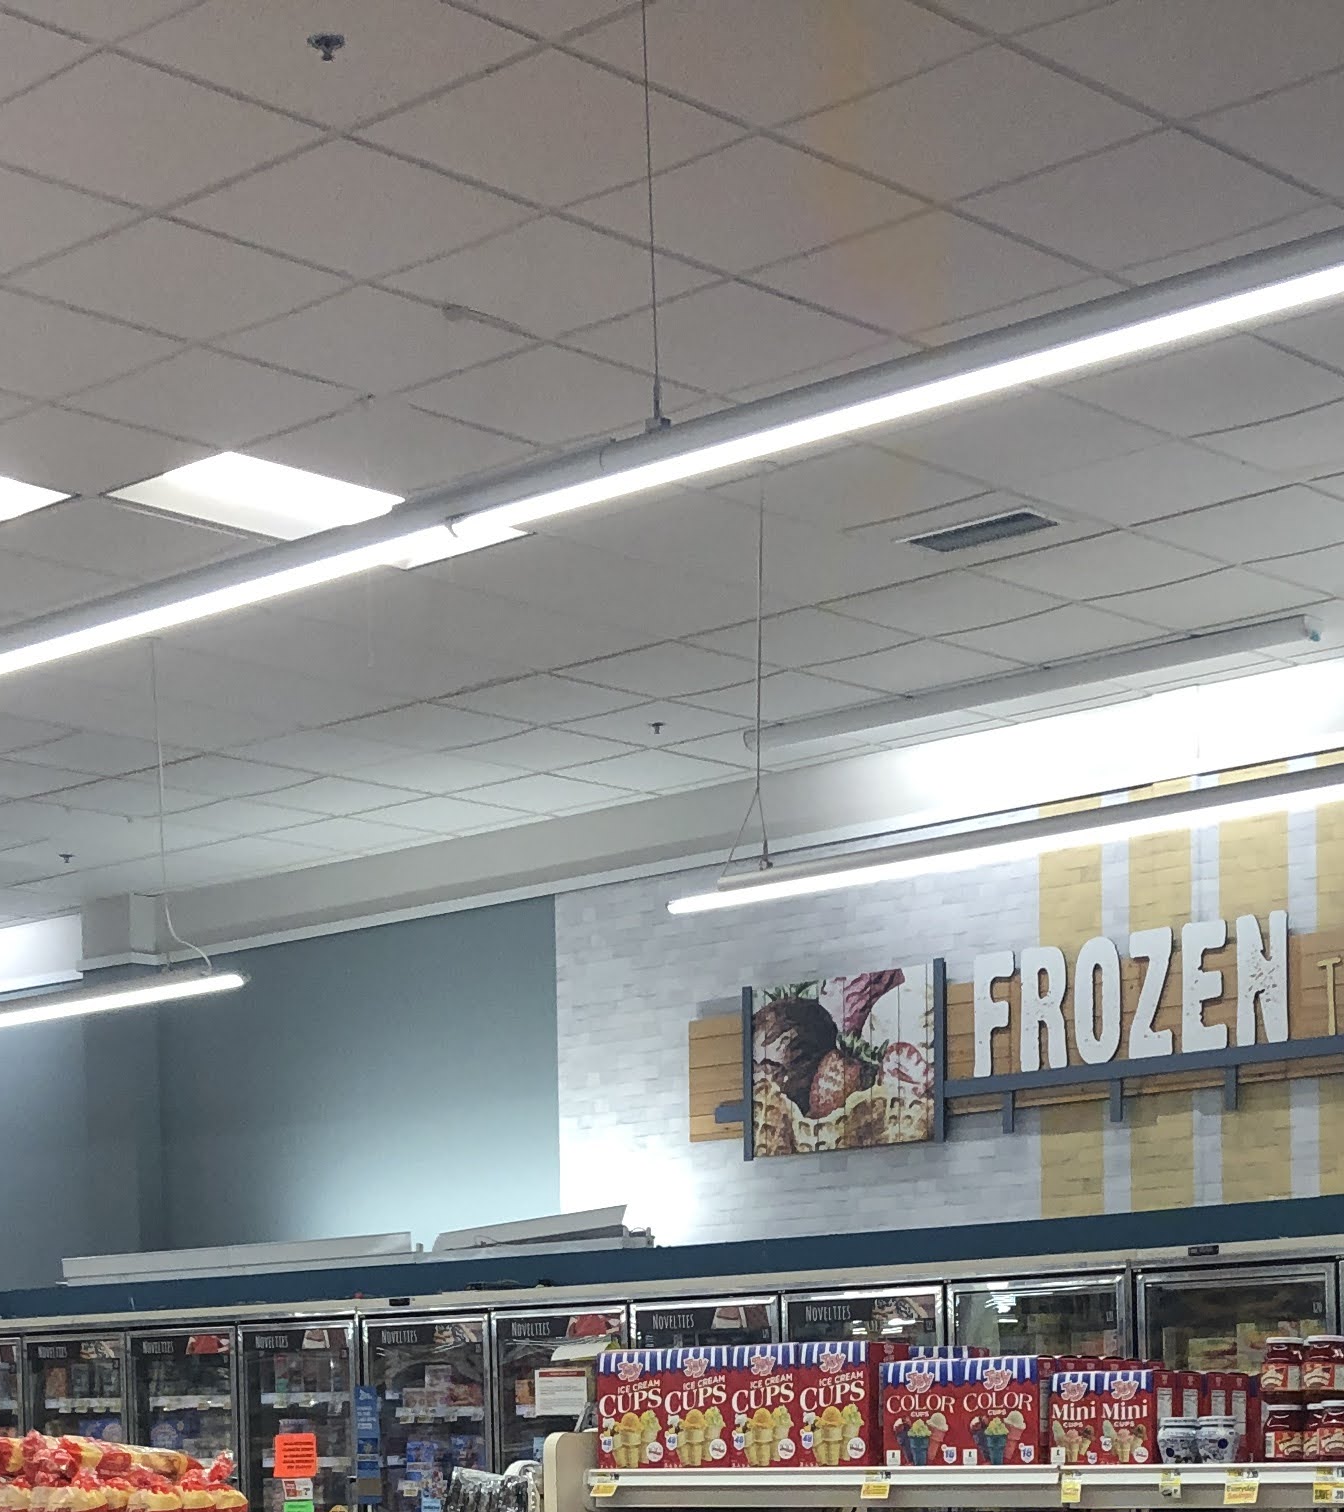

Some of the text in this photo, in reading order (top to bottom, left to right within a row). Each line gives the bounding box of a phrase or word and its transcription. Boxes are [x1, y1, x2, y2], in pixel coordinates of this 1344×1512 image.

[972, 909, 1289, 1077] FROZEN
[653, 1313, 695, 1330] NOVELTIES
[805, 1303, 851, 1322] NOVELTIES
[381, 1329, 418, 1345] NOVELTIES
[511, 1321, 551, 1337] NOVELTIES
[142, 1340, 174, 1354] NOVELTIES
[255, 1334, 289, 1349] NOVELTIES
[617, 1379, 660, 1394] ICE CREAM
[683, 1375, 726, 1390] ICE CREAM
[750, 1373, 793, 1389] ICE CREAM
[819, 1371, 863, 1387] ICE CREAM
[599, 1388, 662, 1417] CUPS
[665, 1384, 727, 1415] CUPS
[732, 1382, 795, 1413] CUPS
[800, 1380, 866, 1412] CUPS
[886, 1393, 956, 1413] COLOR
[963, 1391, 1033, 1412] COLOR
[1052, 1400, 1097, 1420] Mini
[1102, 1399, 1148, 1420] Mini
